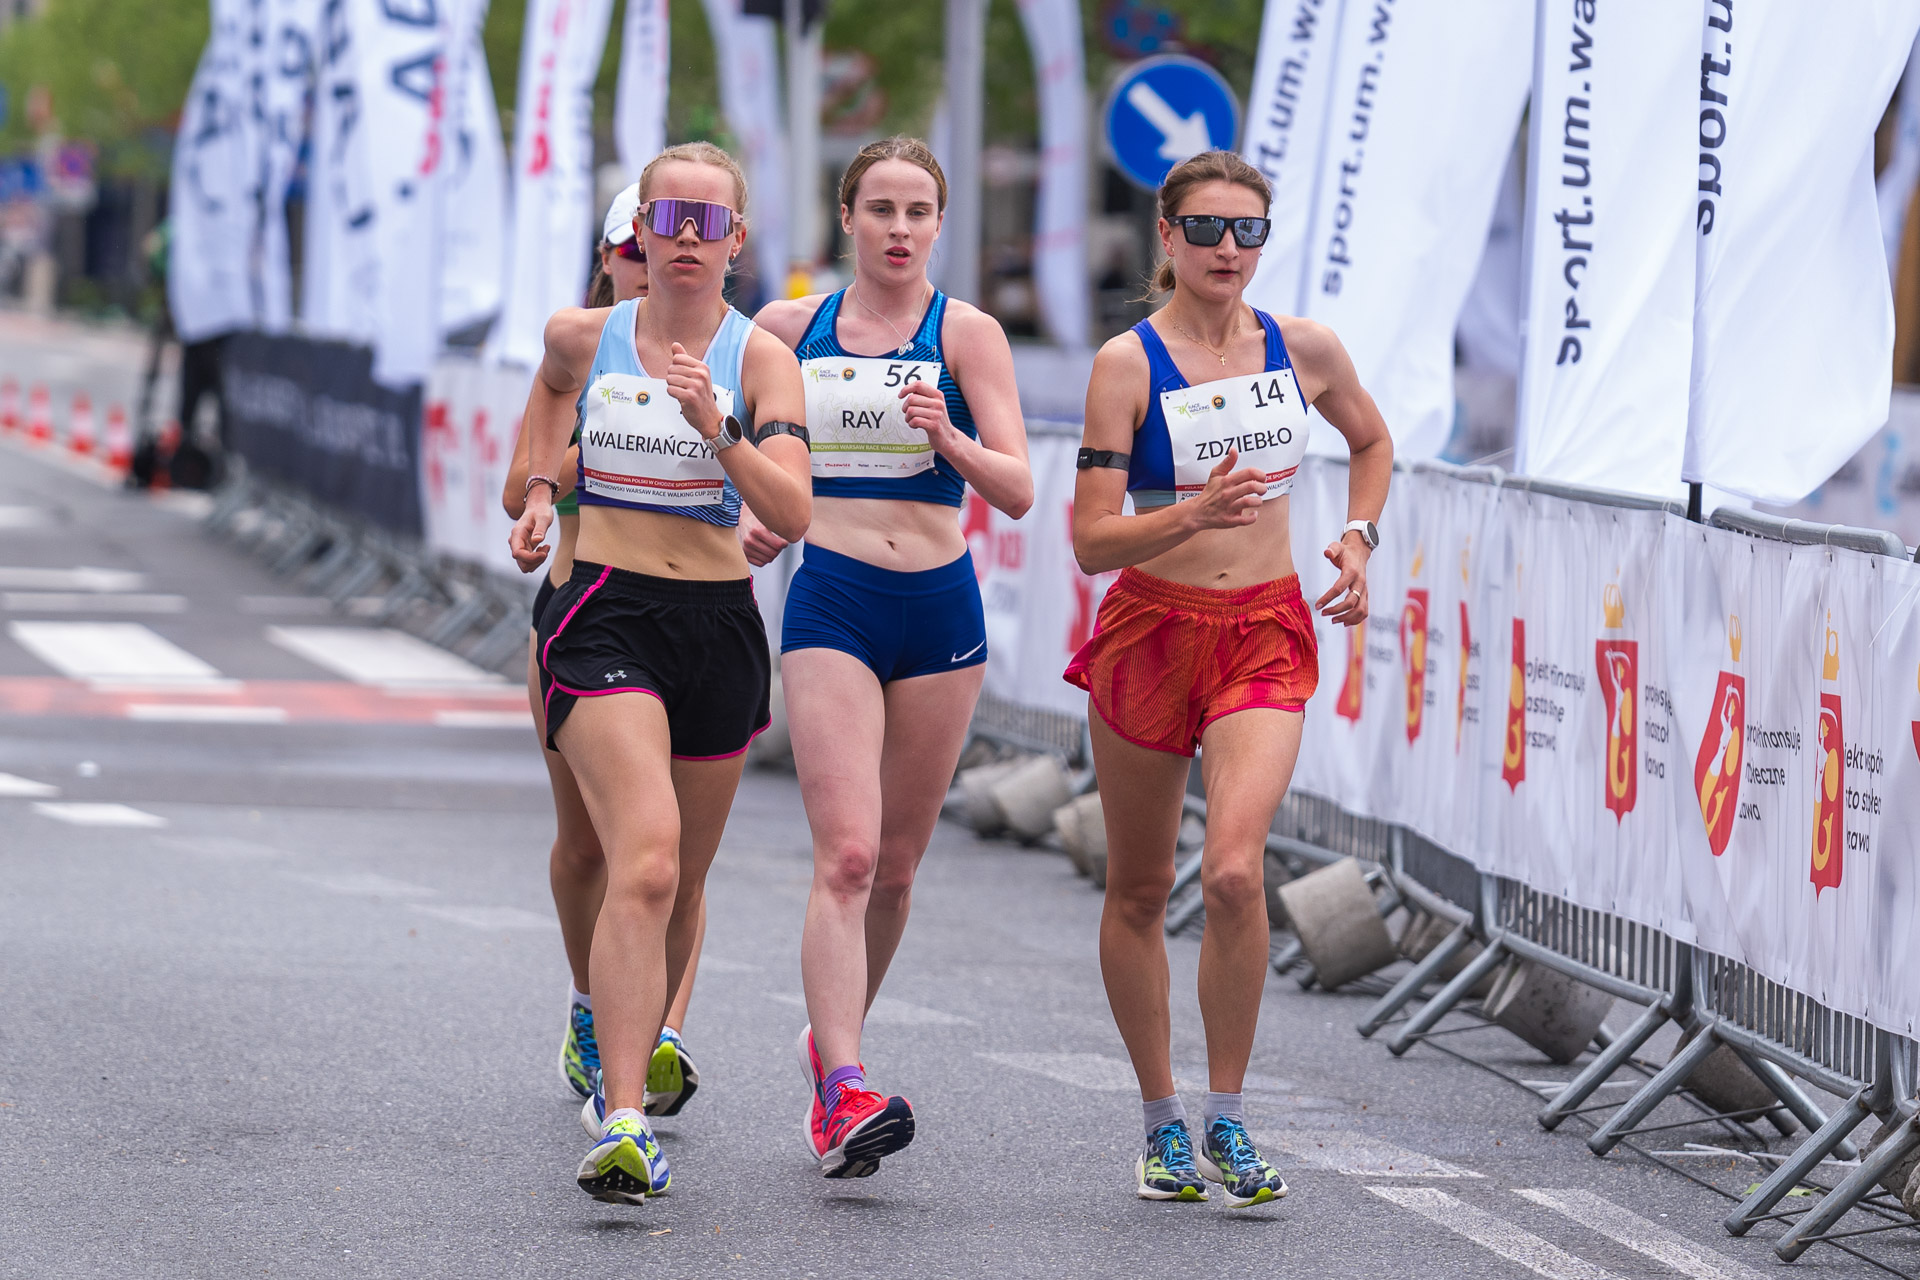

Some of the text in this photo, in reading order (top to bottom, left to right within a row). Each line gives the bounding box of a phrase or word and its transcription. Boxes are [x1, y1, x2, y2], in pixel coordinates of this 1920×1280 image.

[1320, 0, 1396, 297] sport.um.w
[883, 364, 923, 388] 56
[1250, 378, 1285, 409] 14
[842, 410, 885, 429] RAY
[589, 430, 715, 460] WALERIAŃCZY
[1195, 427, 1293, 461] ZDZIEBŁO
[625, 486, 651, 496] WARSAW
[652, 489, 666, 497] RACE
